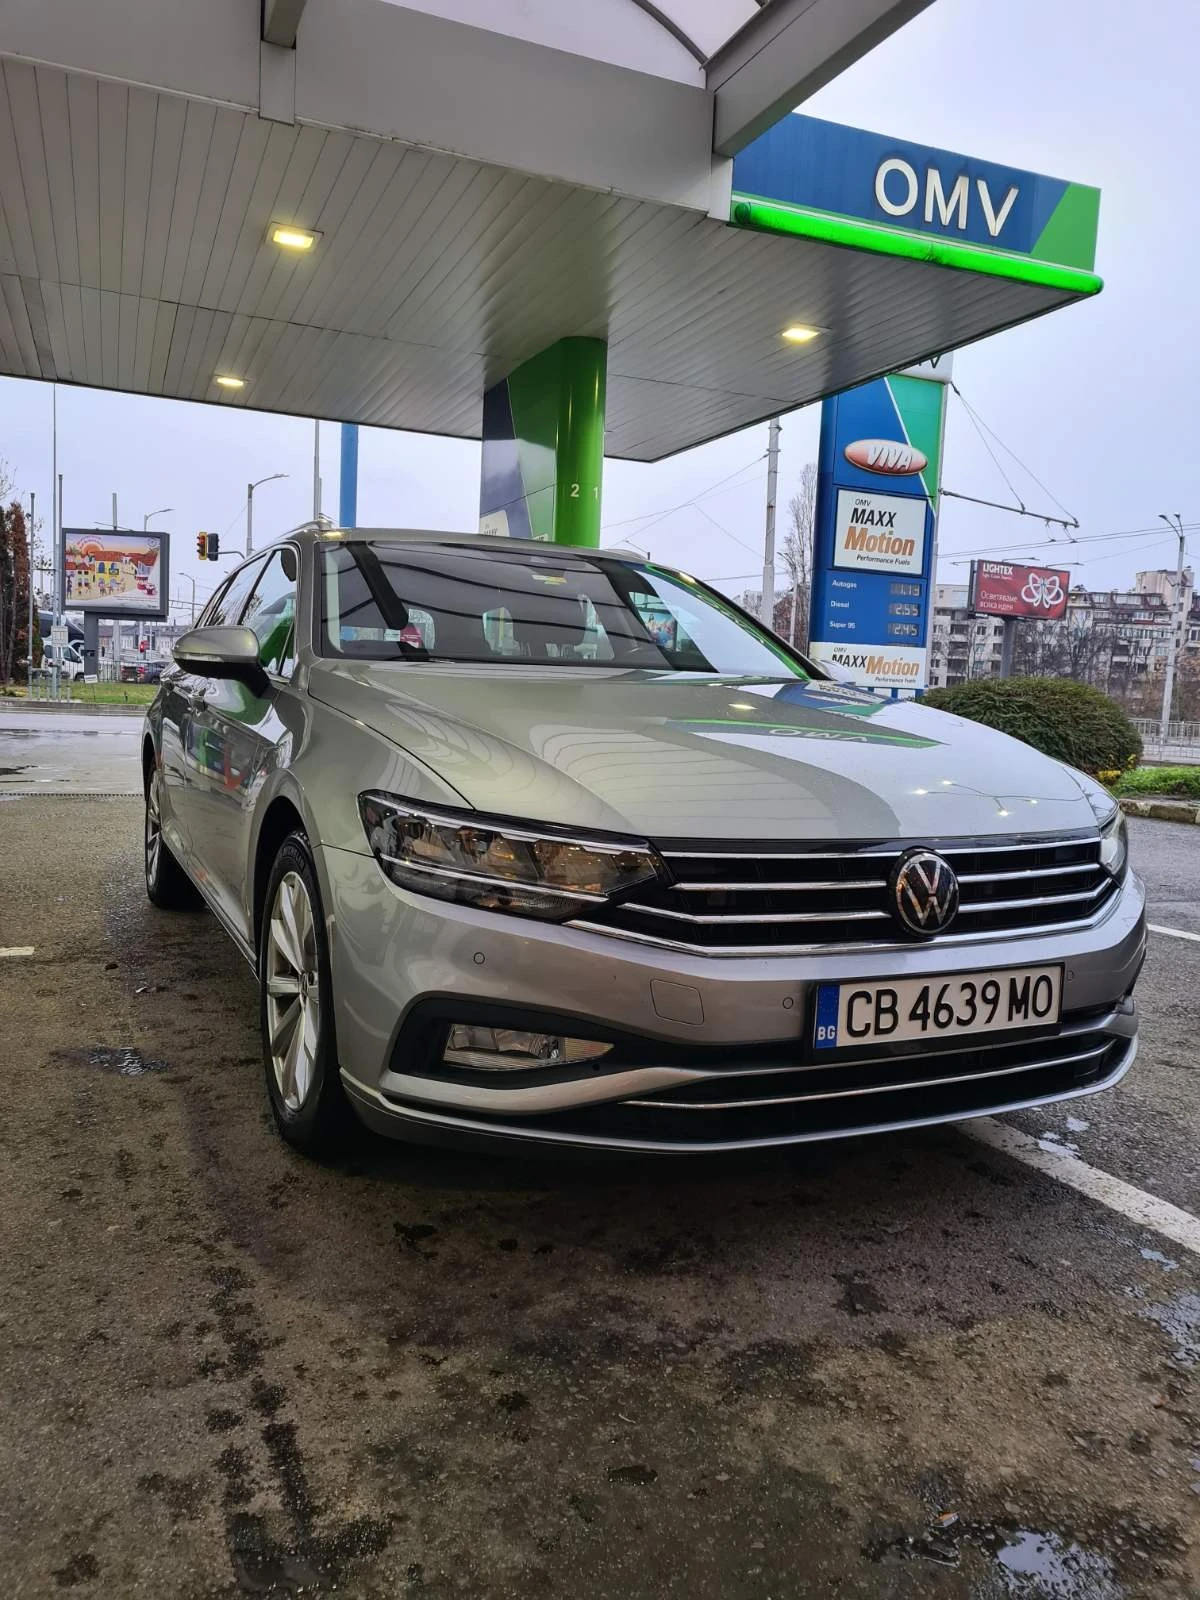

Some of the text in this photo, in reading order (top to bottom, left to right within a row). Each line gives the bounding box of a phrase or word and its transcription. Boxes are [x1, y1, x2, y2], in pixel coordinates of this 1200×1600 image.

[875, 158, 1020, 238] OMV
[867, 446, 912, 471] VIVA
[570, 483, 580, 498] 2
[593, 486, 599, 500] 1
[855, 498, 872, 507] OMV
[850, 507, 896, 527] MAXX
[844, 526, 915, 556] Motion
[856, 554, 911, 567] Performance Fuels
[983, 562, 1013, 575] LIGHTEX
[830, 600, 850, 609] Diesel
[829, 620, 847, 630] Super
[866, 656, 919, 675] Motion
[846, 974, 1054, 1038] CB 4639 MO
[817, 1025, 836, 1041] BG
